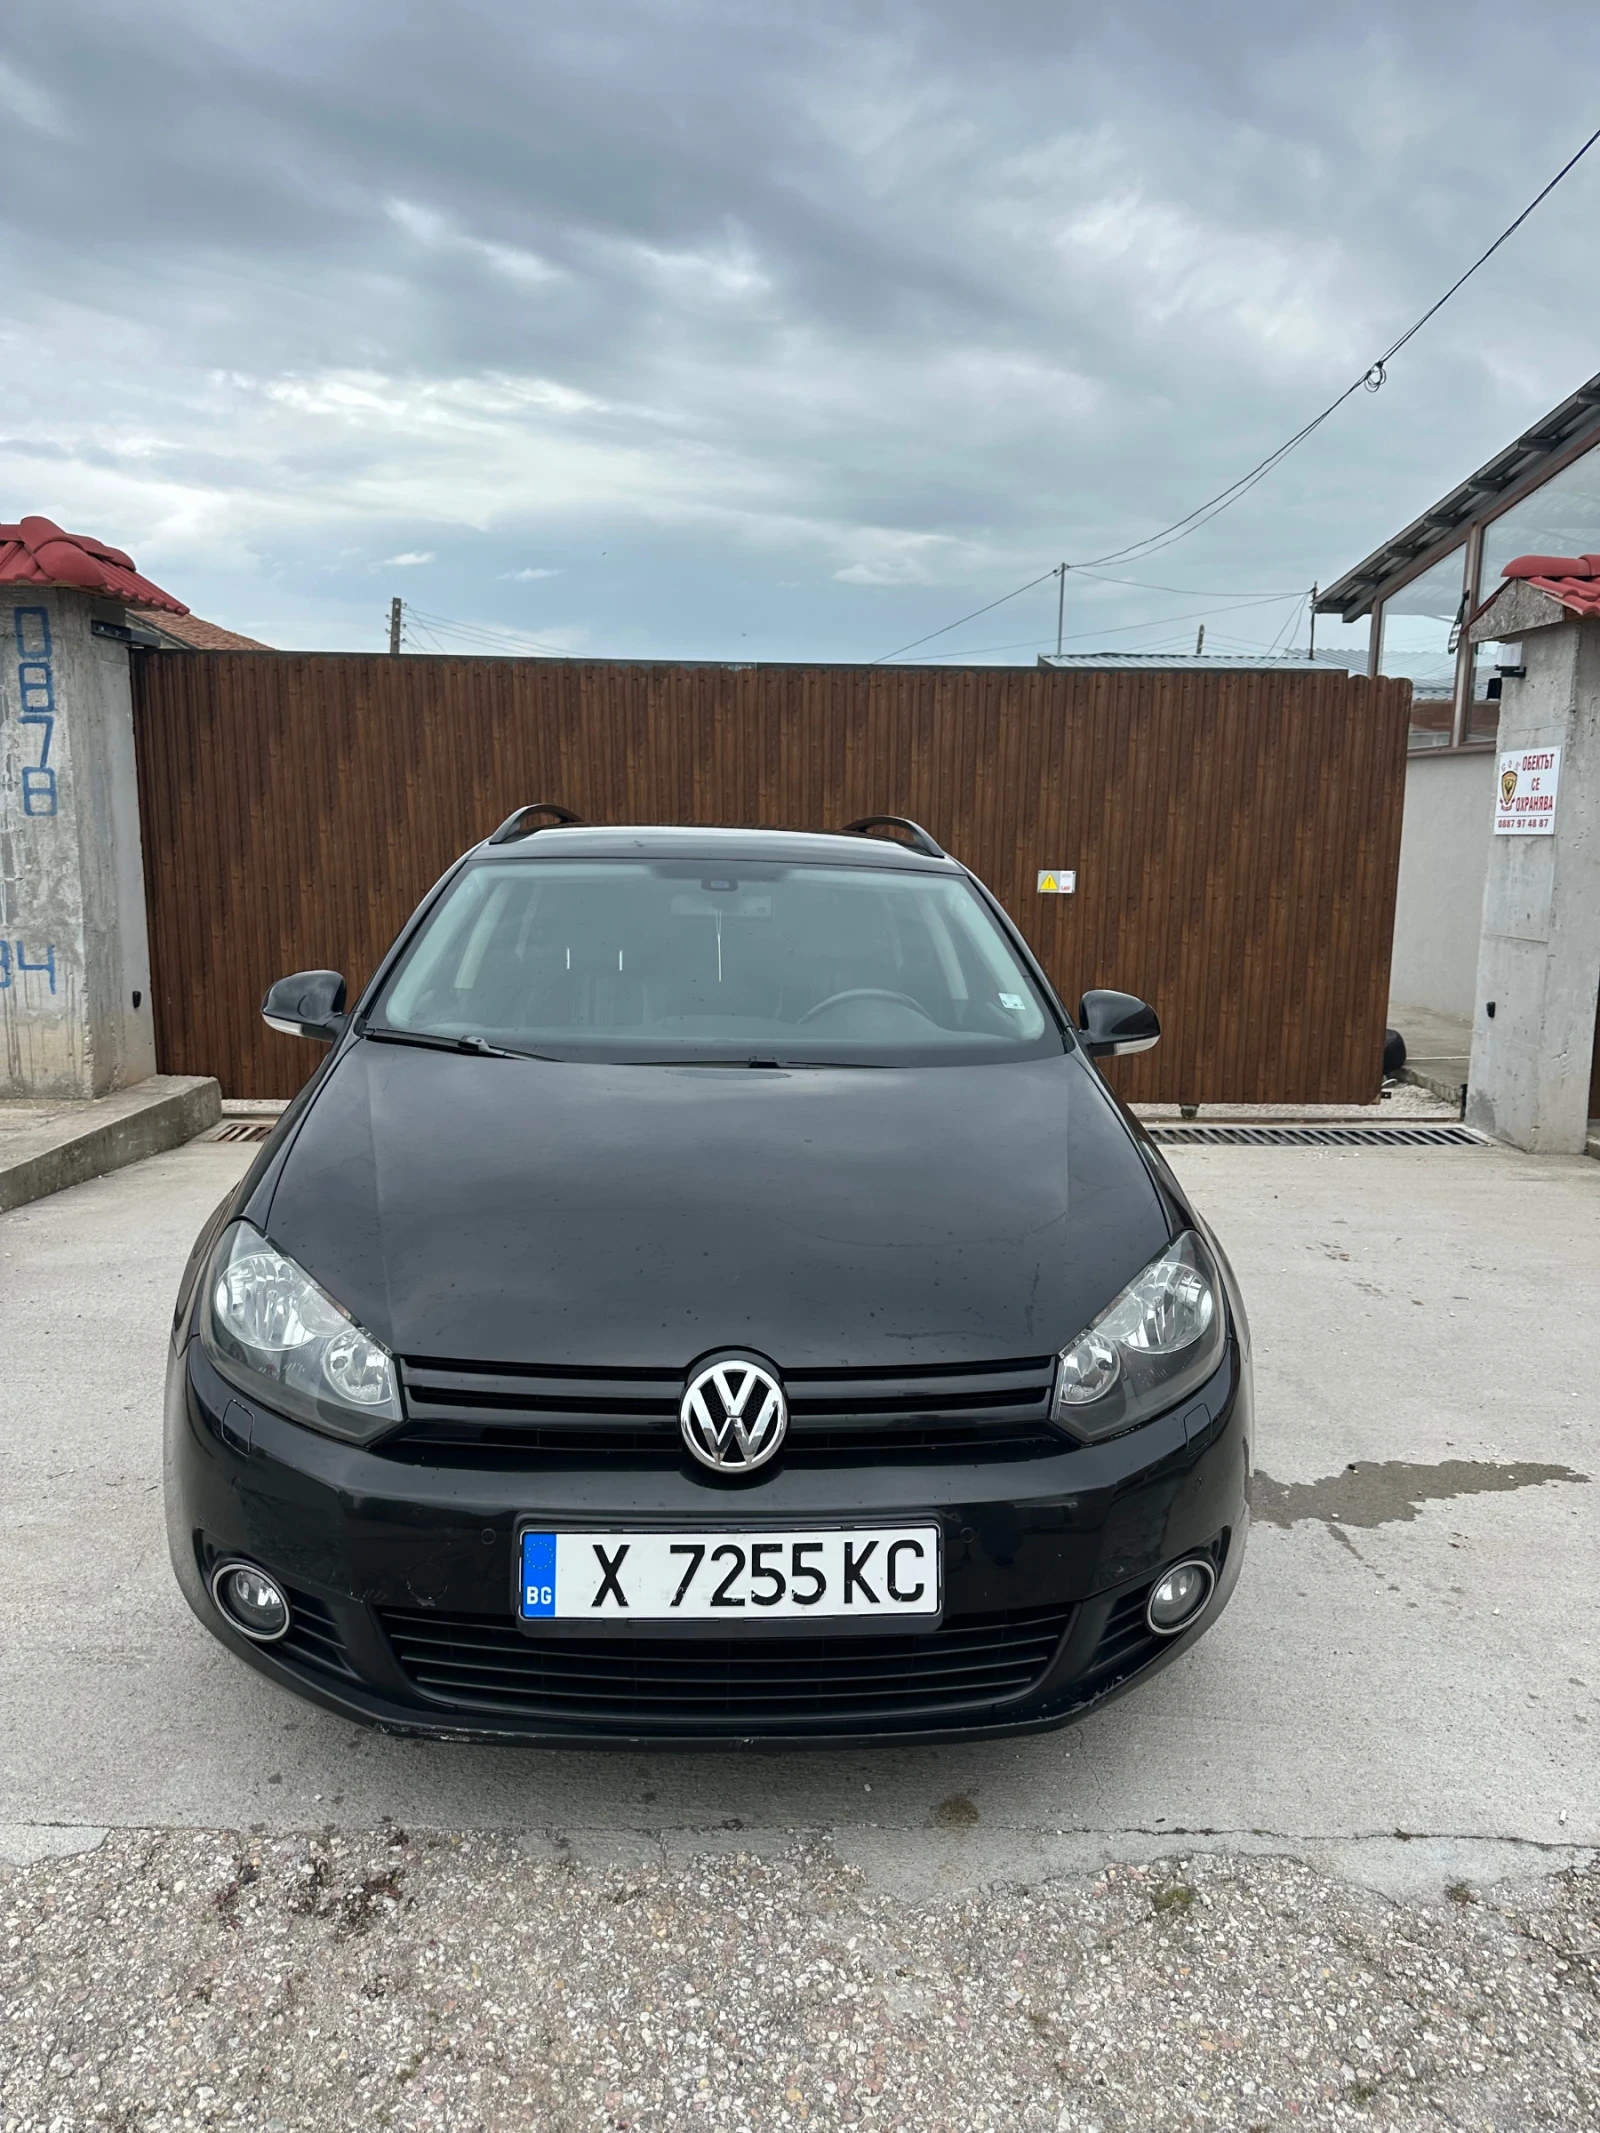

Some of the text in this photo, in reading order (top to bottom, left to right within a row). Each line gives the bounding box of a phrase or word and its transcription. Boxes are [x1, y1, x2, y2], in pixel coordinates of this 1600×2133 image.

[14, 606, 58, 817] 0878
[1522, 753, 1555, 771] ОБЕКТЪТ
[1531, 777, 1541, 791] СЕ
[1515, 795, 1553, 812] ОХРАНЯВА
[1516, 819, 1526, 828] 97
[1527, 818, 1537, 828] 48
[1538, 818, 1549, 828] 87
[681, 1360, 787, 1474] VW
[669, 1542, 827, 1607] 7255
[526, 1585, 553, 1606] BG
